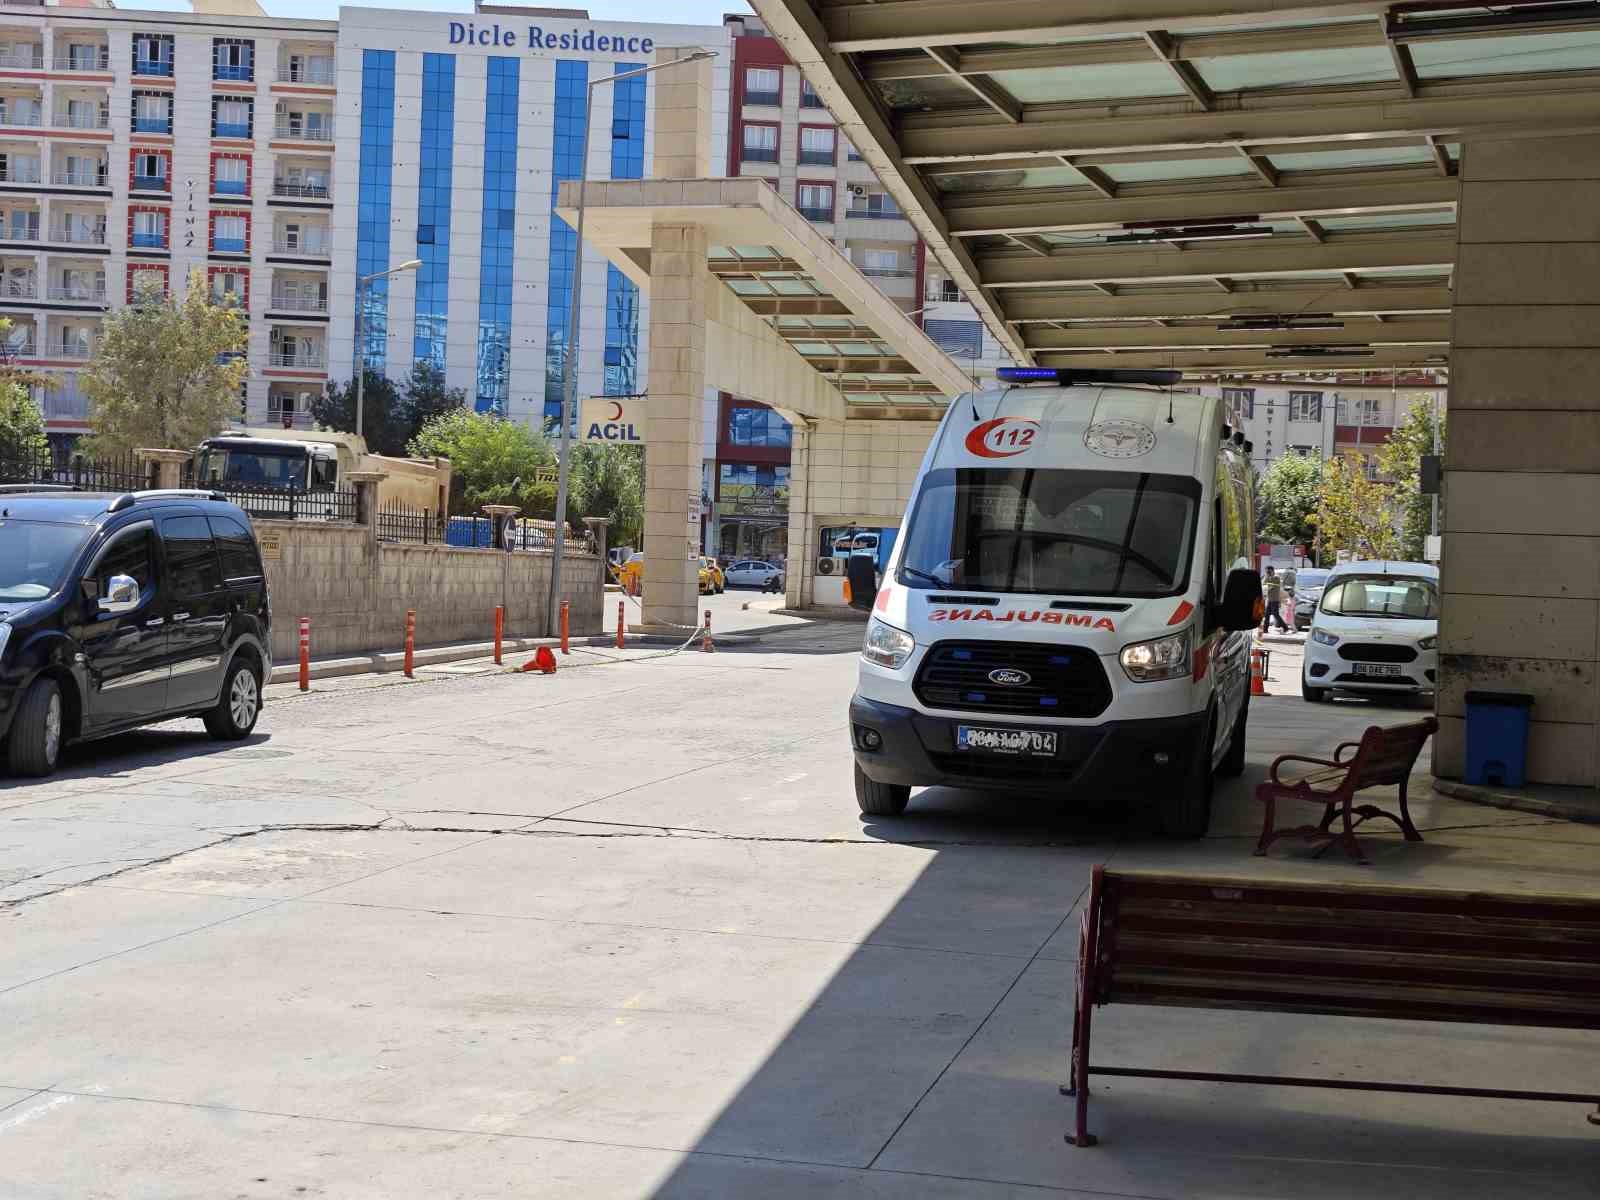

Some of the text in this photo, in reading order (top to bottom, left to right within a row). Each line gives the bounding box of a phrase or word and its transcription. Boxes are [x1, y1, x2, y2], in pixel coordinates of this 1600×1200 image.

[449, 22, 654, 54] Dicle Residence
[994, 428, 1035, 446] 112
[997, 671, 1021, 683] Ford
